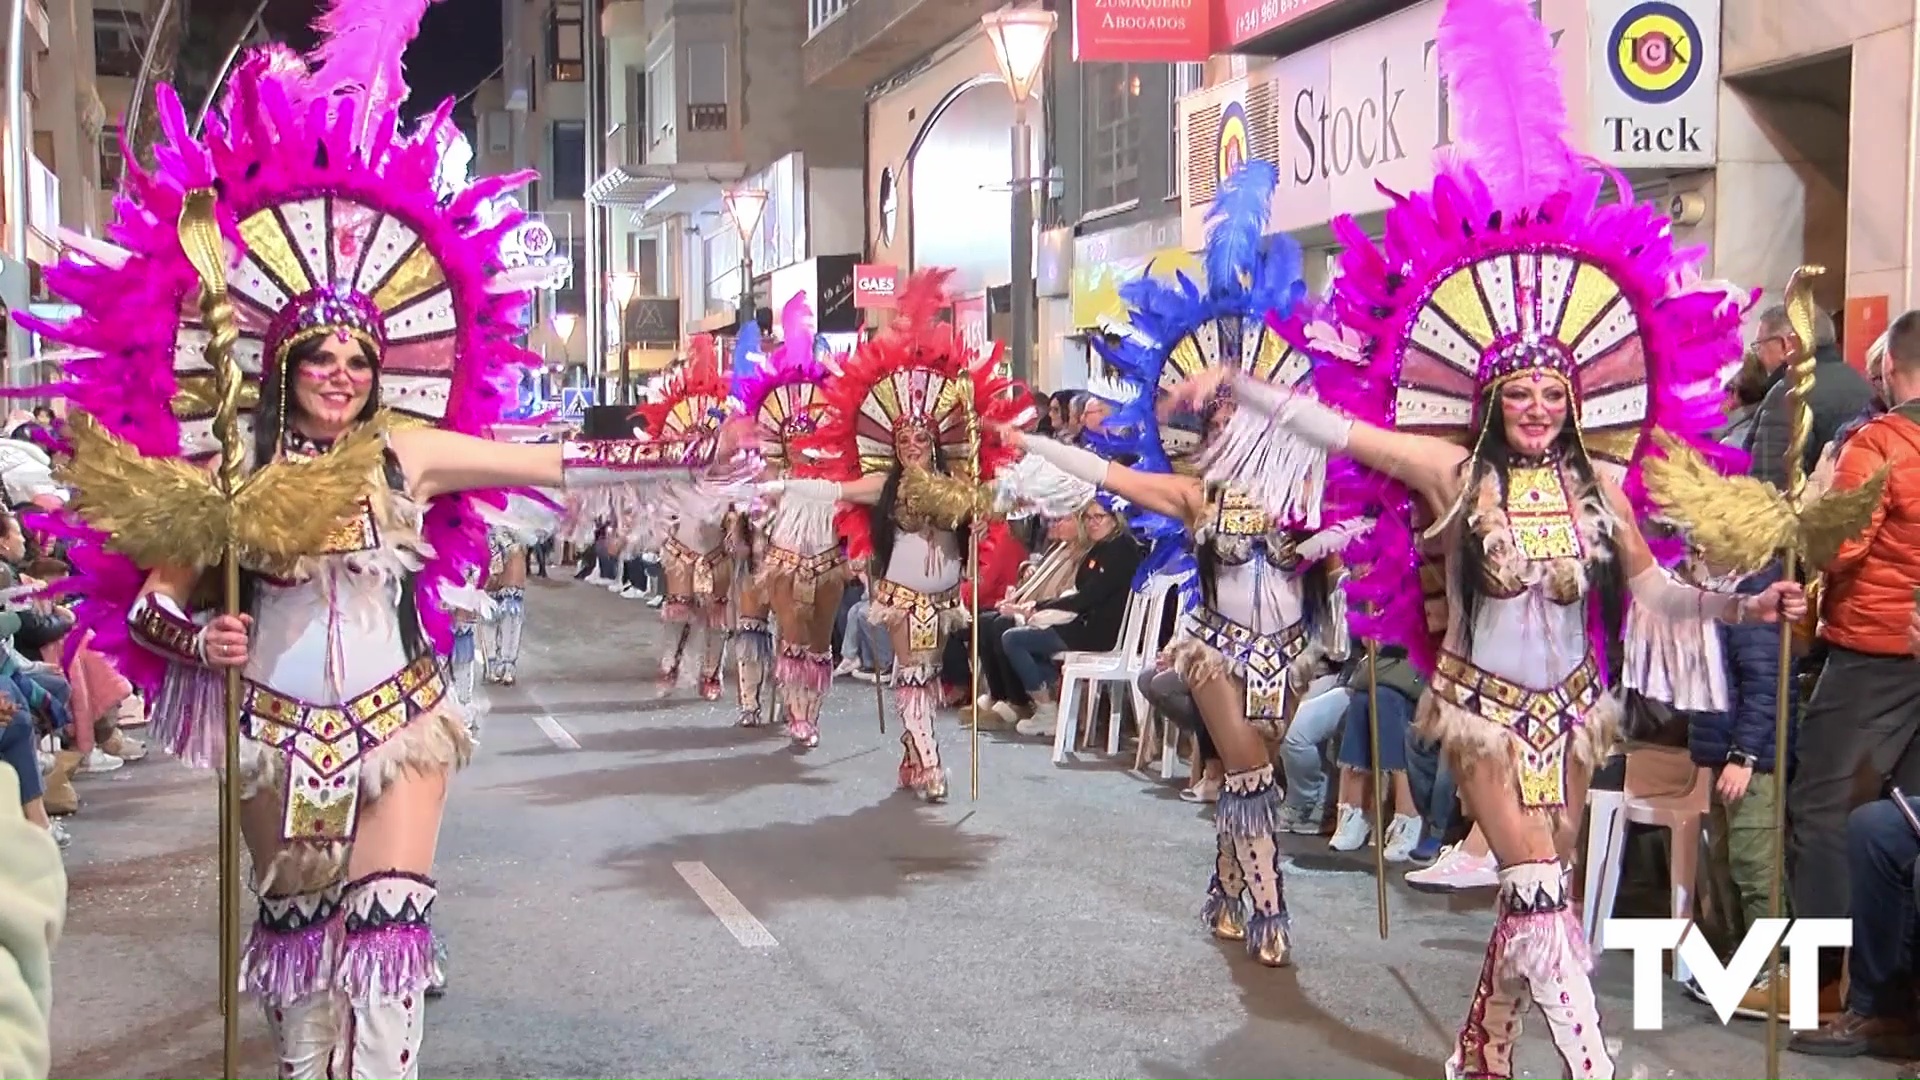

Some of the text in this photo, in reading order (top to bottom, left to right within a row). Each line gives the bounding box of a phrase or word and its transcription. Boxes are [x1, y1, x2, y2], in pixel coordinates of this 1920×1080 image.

[1101, 12, 1186, 29] ABOGADOS
[1293, 56, 1407, 188] Stock
[1604, 117, 1702, 152] Tack
[858, 277, 895, 290] GAES
